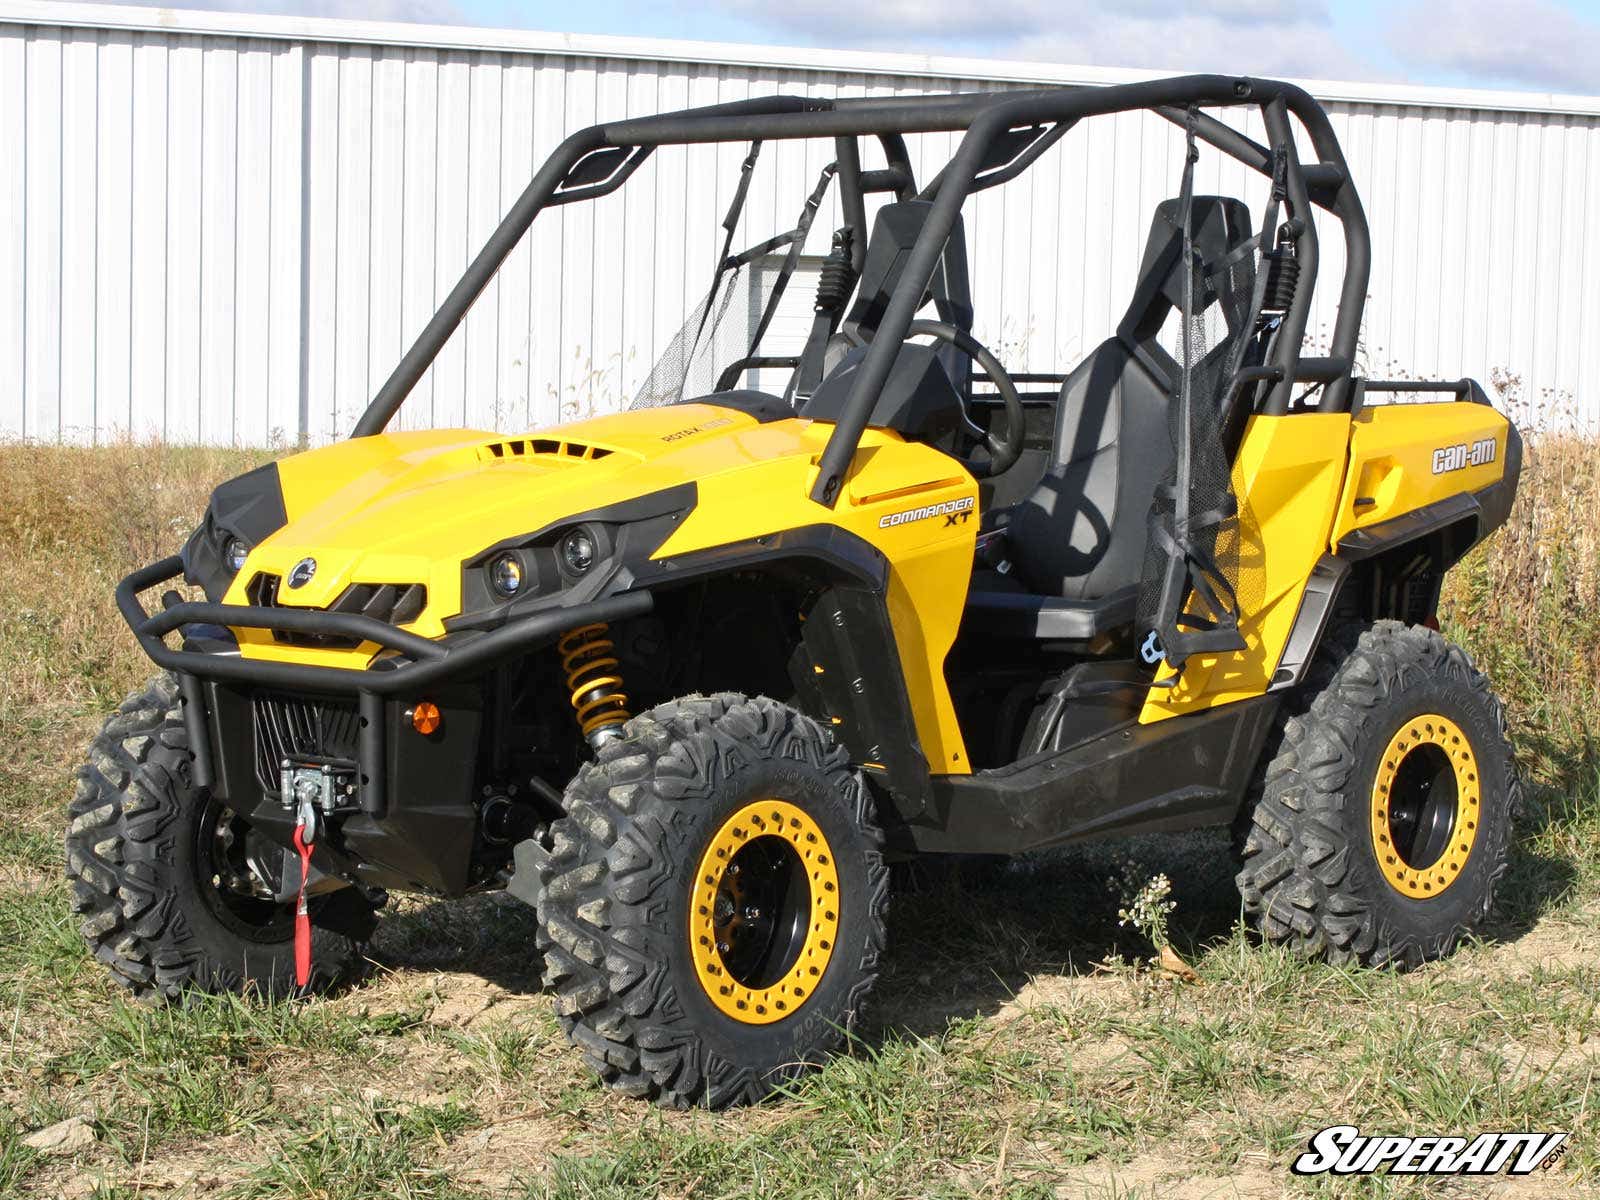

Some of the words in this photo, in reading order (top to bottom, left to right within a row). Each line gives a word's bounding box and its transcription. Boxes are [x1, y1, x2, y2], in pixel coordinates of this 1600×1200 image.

[661, 427, 701, 442] ROTAX
[1432, 438, 1496, 474] can-am
[879, 496, 974, 528] COMMANDER
[944, 510, 973, 527] XT
